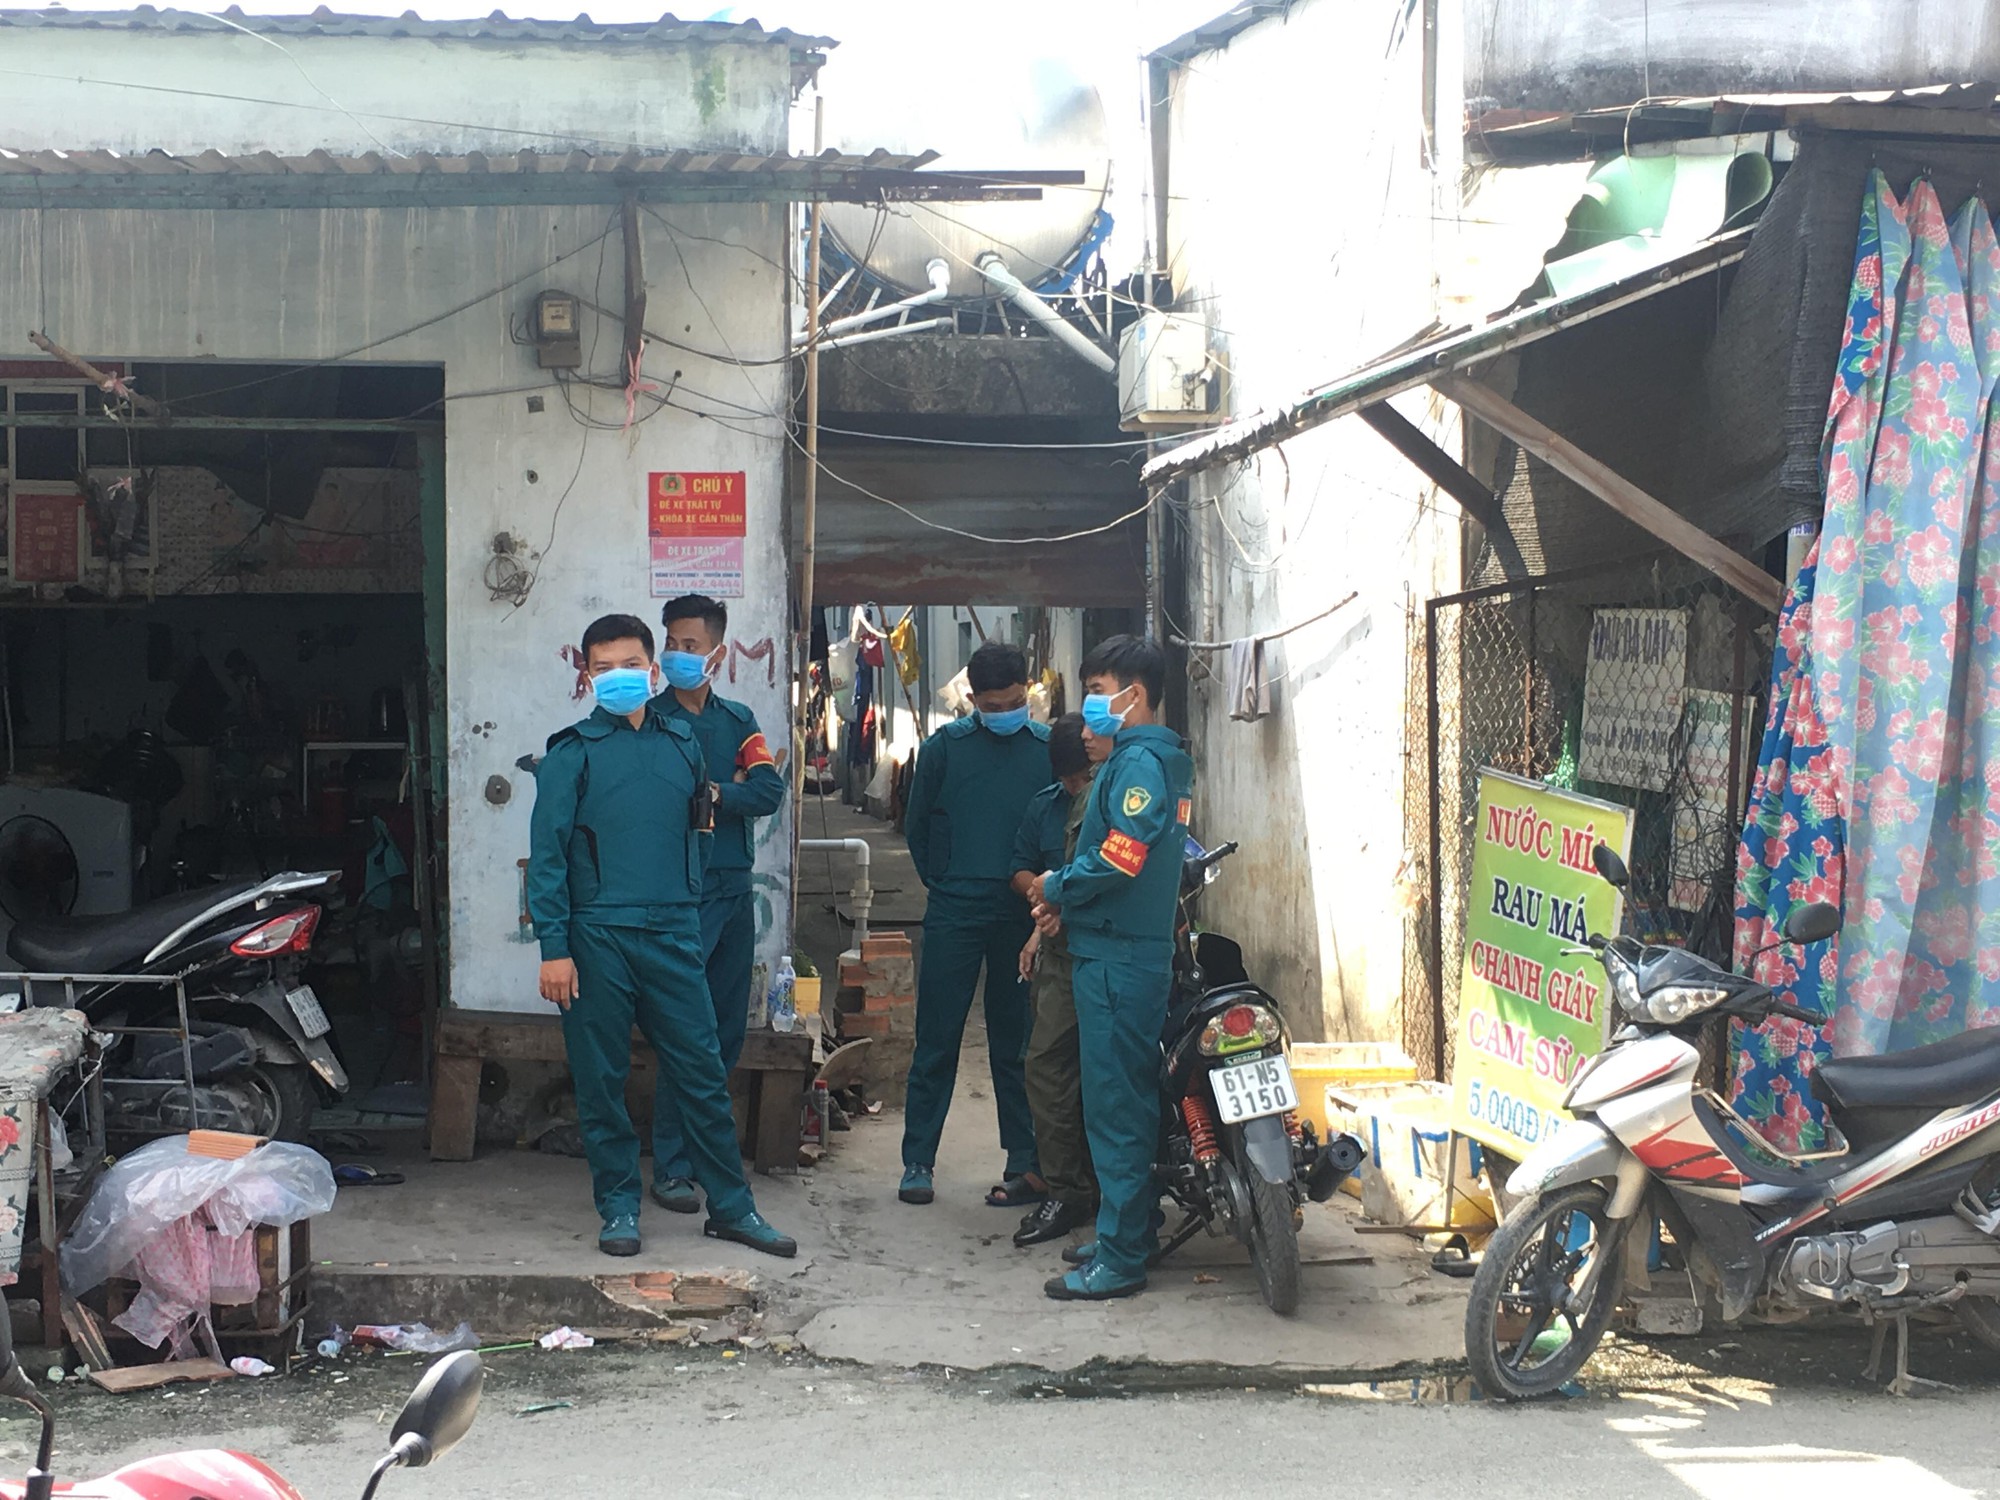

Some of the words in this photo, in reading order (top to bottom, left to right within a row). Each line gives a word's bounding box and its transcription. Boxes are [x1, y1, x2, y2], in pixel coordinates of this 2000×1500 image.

[673, 501, 684, 510] XE
[692, 476, 721, 493] CHÚ
[685, 514, 696, 523] XE
[1486, 805, 1553, 859] NƯỚC
[1491, 878, 1543, 928] RAU
[1548, 896, 1590, 946] MÁ
[1471, 941, 1544, 1001] CHANH
[1547, 970, 1598, 1023] GIÂY
[1469, 1012, 1527, 1066] CAM
[1222, 1060, 1280, 1093] 61-N5
[1229, 1085, 1288, 1117] 3150
[1919, 1101, 2000, 1154] JUPITE
